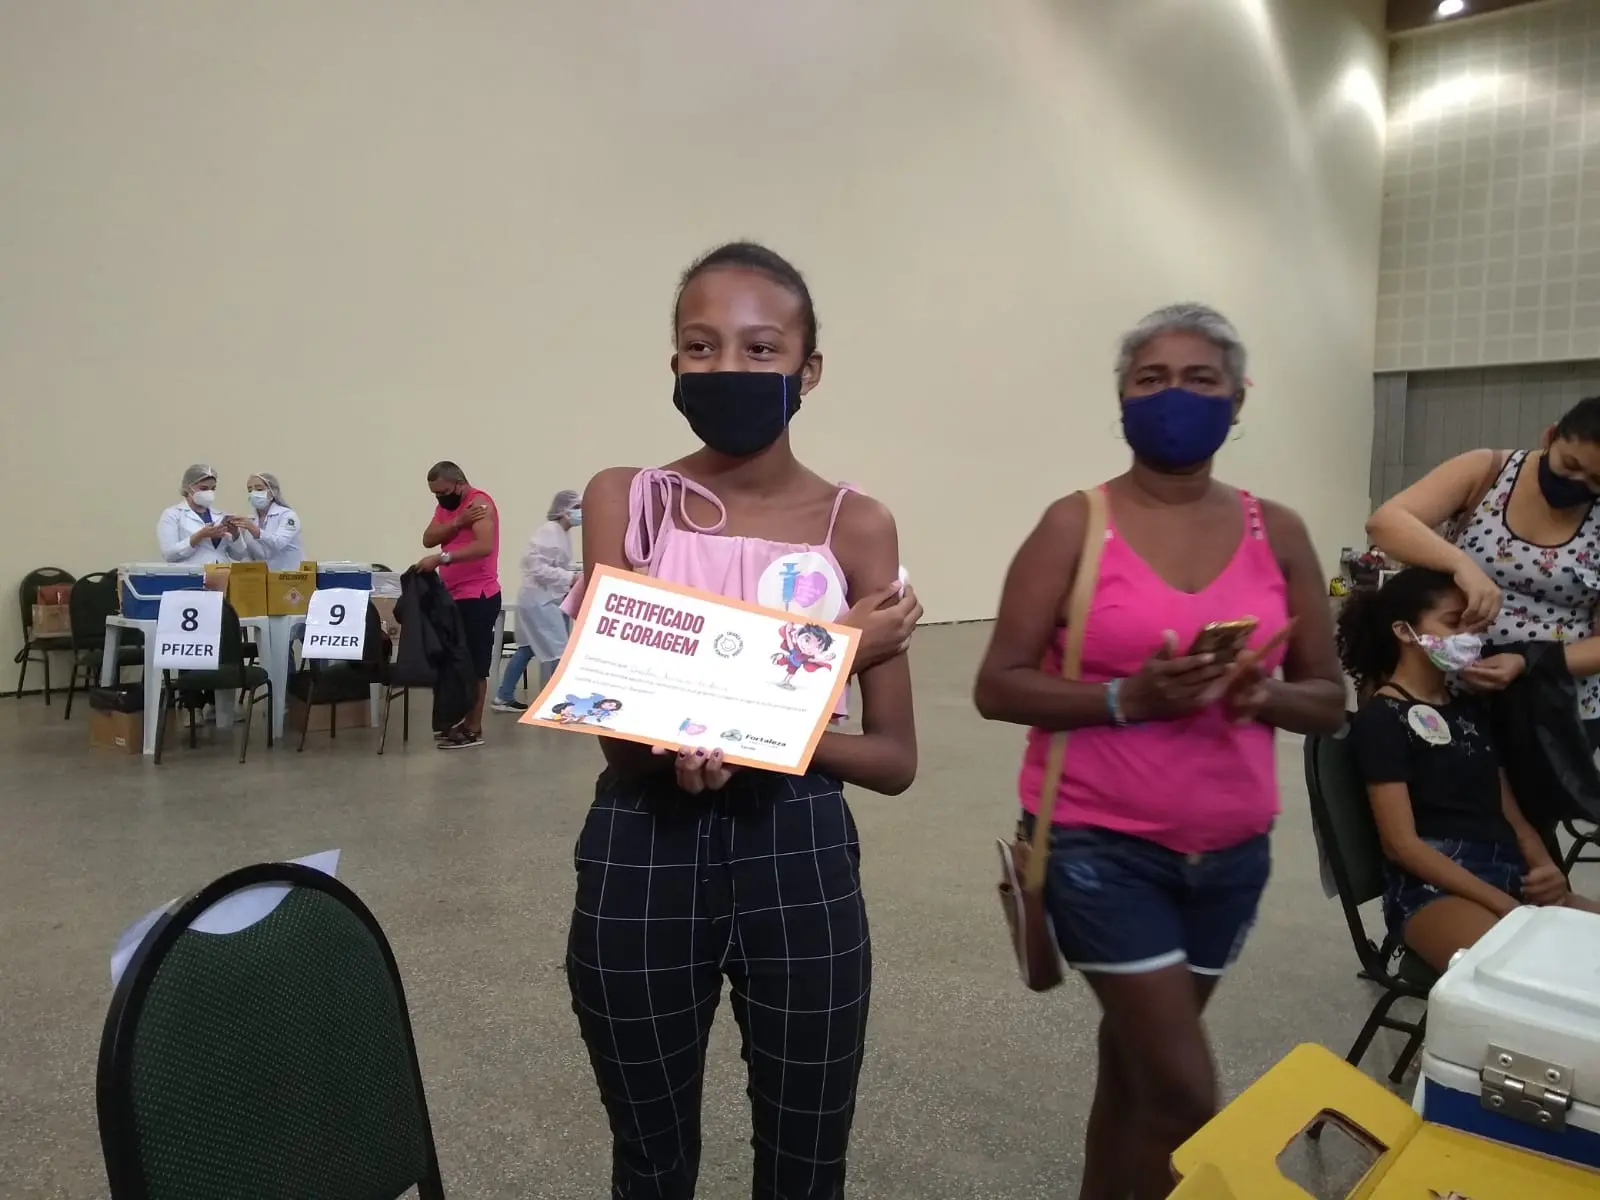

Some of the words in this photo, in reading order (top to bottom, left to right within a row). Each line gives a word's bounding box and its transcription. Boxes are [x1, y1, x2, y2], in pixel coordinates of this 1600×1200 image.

[181, 608, 199, 631] 8
[328, 604, 346, 626] 9
[604, 593, 705, 634] CERTIFICADO
[310, 635, 359, 647] PFIZER
[596, 616, 620, 638] DE
[620, 622, 699, 656] CORAGEM
[161, 643, 213, 656] PFIZER
[745, 734, 786, 747] Fortaleza
